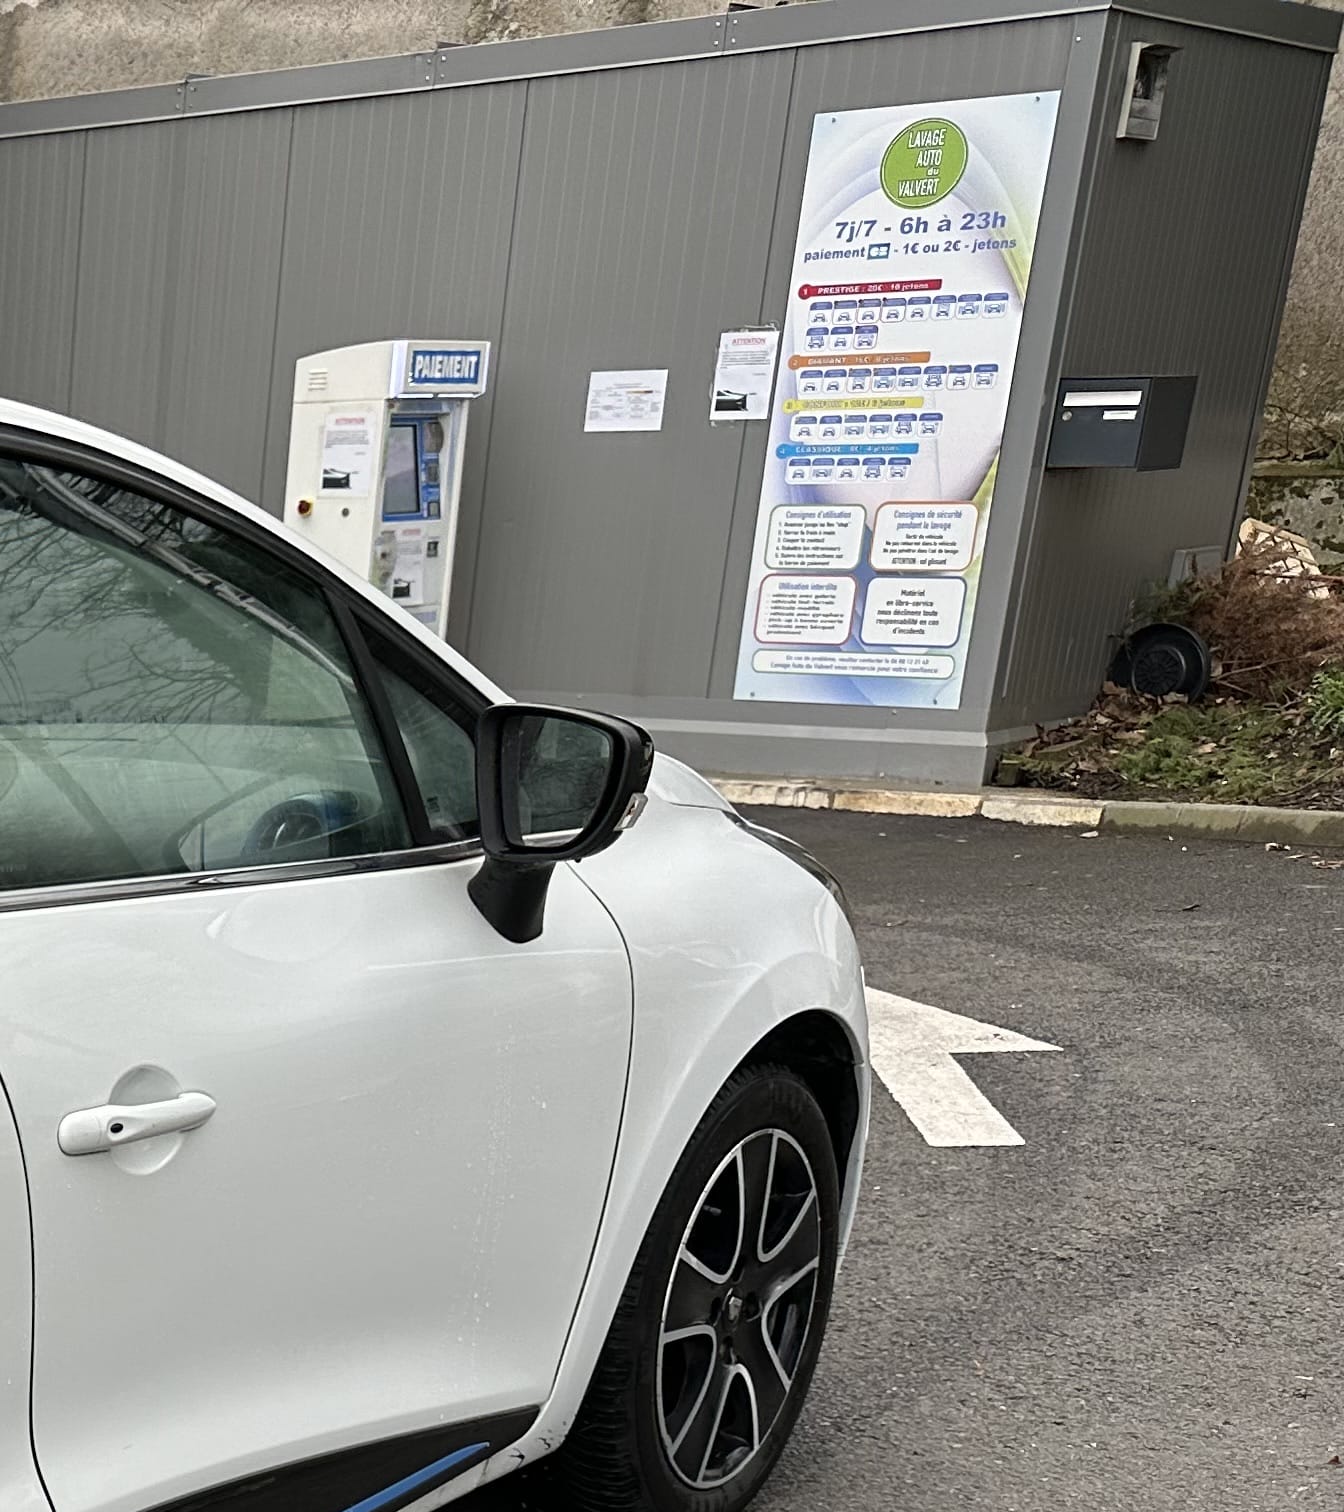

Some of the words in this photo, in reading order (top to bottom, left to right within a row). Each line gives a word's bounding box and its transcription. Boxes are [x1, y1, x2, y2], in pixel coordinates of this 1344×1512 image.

[908, 128, 946, 149] LAVAGE
[916, 149, 942, 167] AUTO
[927, 168, 939, 176] du
[898, 178, 940, 197] VALVERT
[835, 219, 877, 243] 7j/7
[900, 216, 929, 234] 6h
[937, 214, 952, 232] à
[960, 211, 1007, 230] 23h
[804, 246, 866, 263] paiement
[903, 242, 920, 255] 1€
[923, 243, 939, 254] ou
[943, 240, 961, 252] 2€
[971, 238, 1017, 254] jetons
[817, 285, 860, 295] PRESTIGE
[414, 354, 478, 379] PAIEMENT
